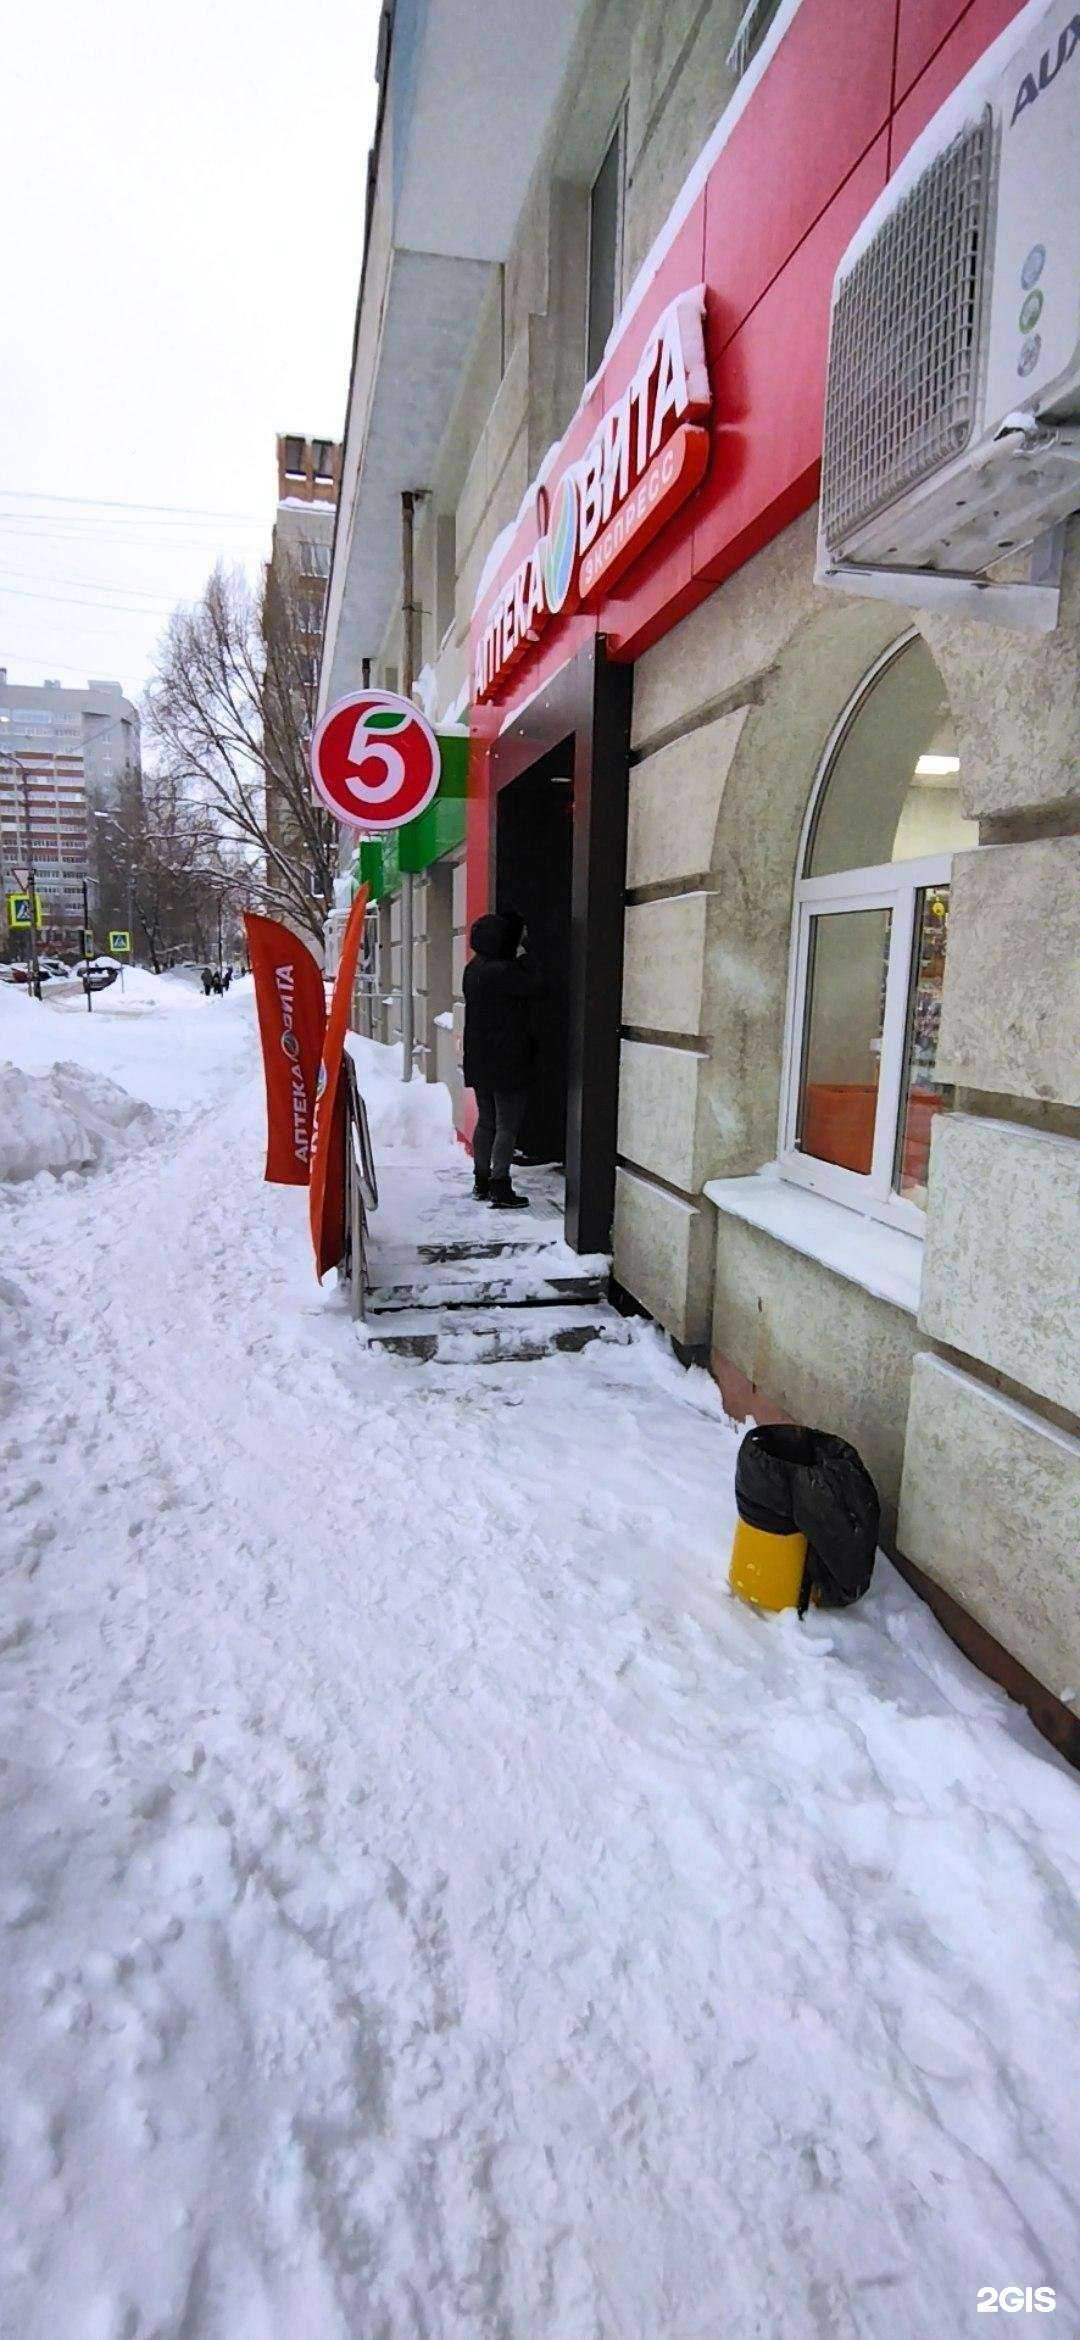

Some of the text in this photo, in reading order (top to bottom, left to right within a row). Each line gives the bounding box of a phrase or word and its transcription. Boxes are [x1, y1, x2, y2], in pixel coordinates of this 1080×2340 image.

[474, 302, 690, 704] АПТЕКА ВИТА
[584, 450, 675, 584] ЭКСПРЕСС
[345, 704, 414, 804] 5
[291, 1064, 309, 1164] АПТЕКА
